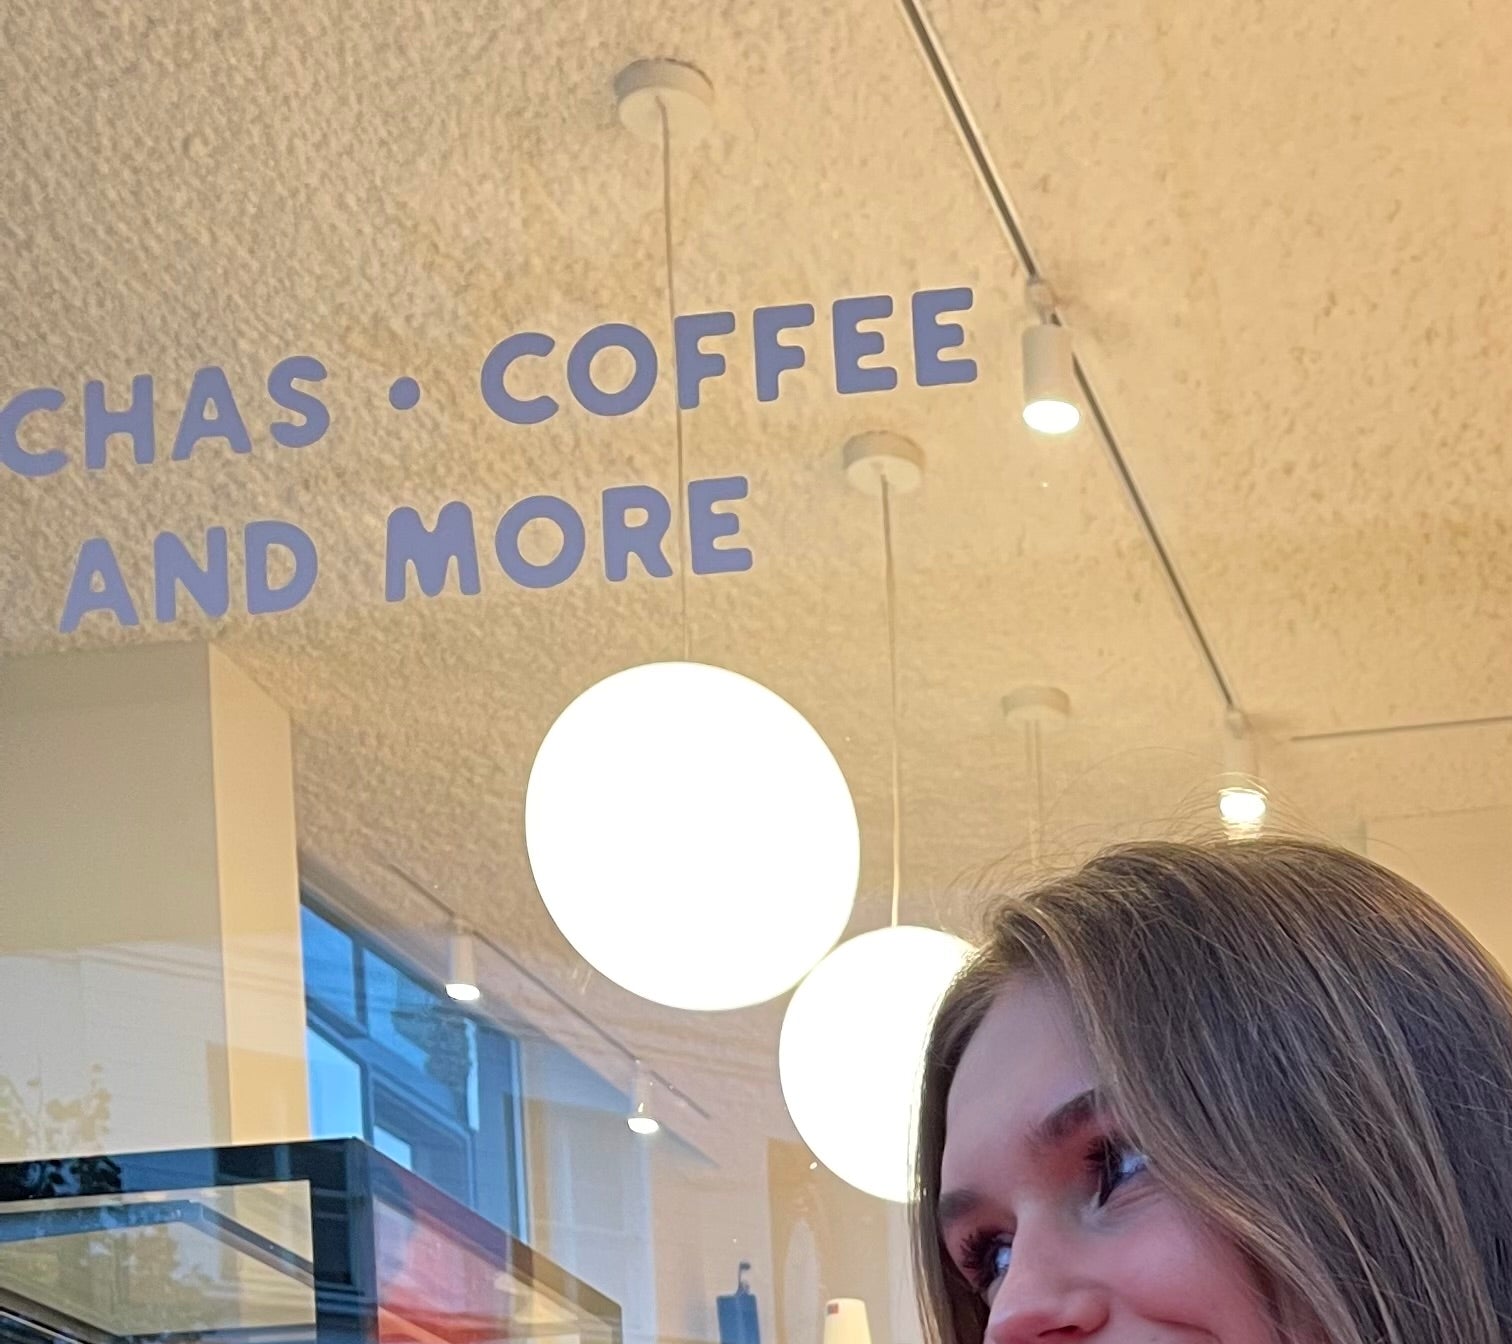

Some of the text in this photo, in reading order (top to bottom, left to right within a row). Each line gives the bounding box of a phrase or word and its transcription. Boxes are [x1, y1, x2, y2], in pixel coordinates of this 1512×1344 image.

[0, 288, 977, 477] CHAS COFFEE
[58, 477, 752, 633] AND MORE
